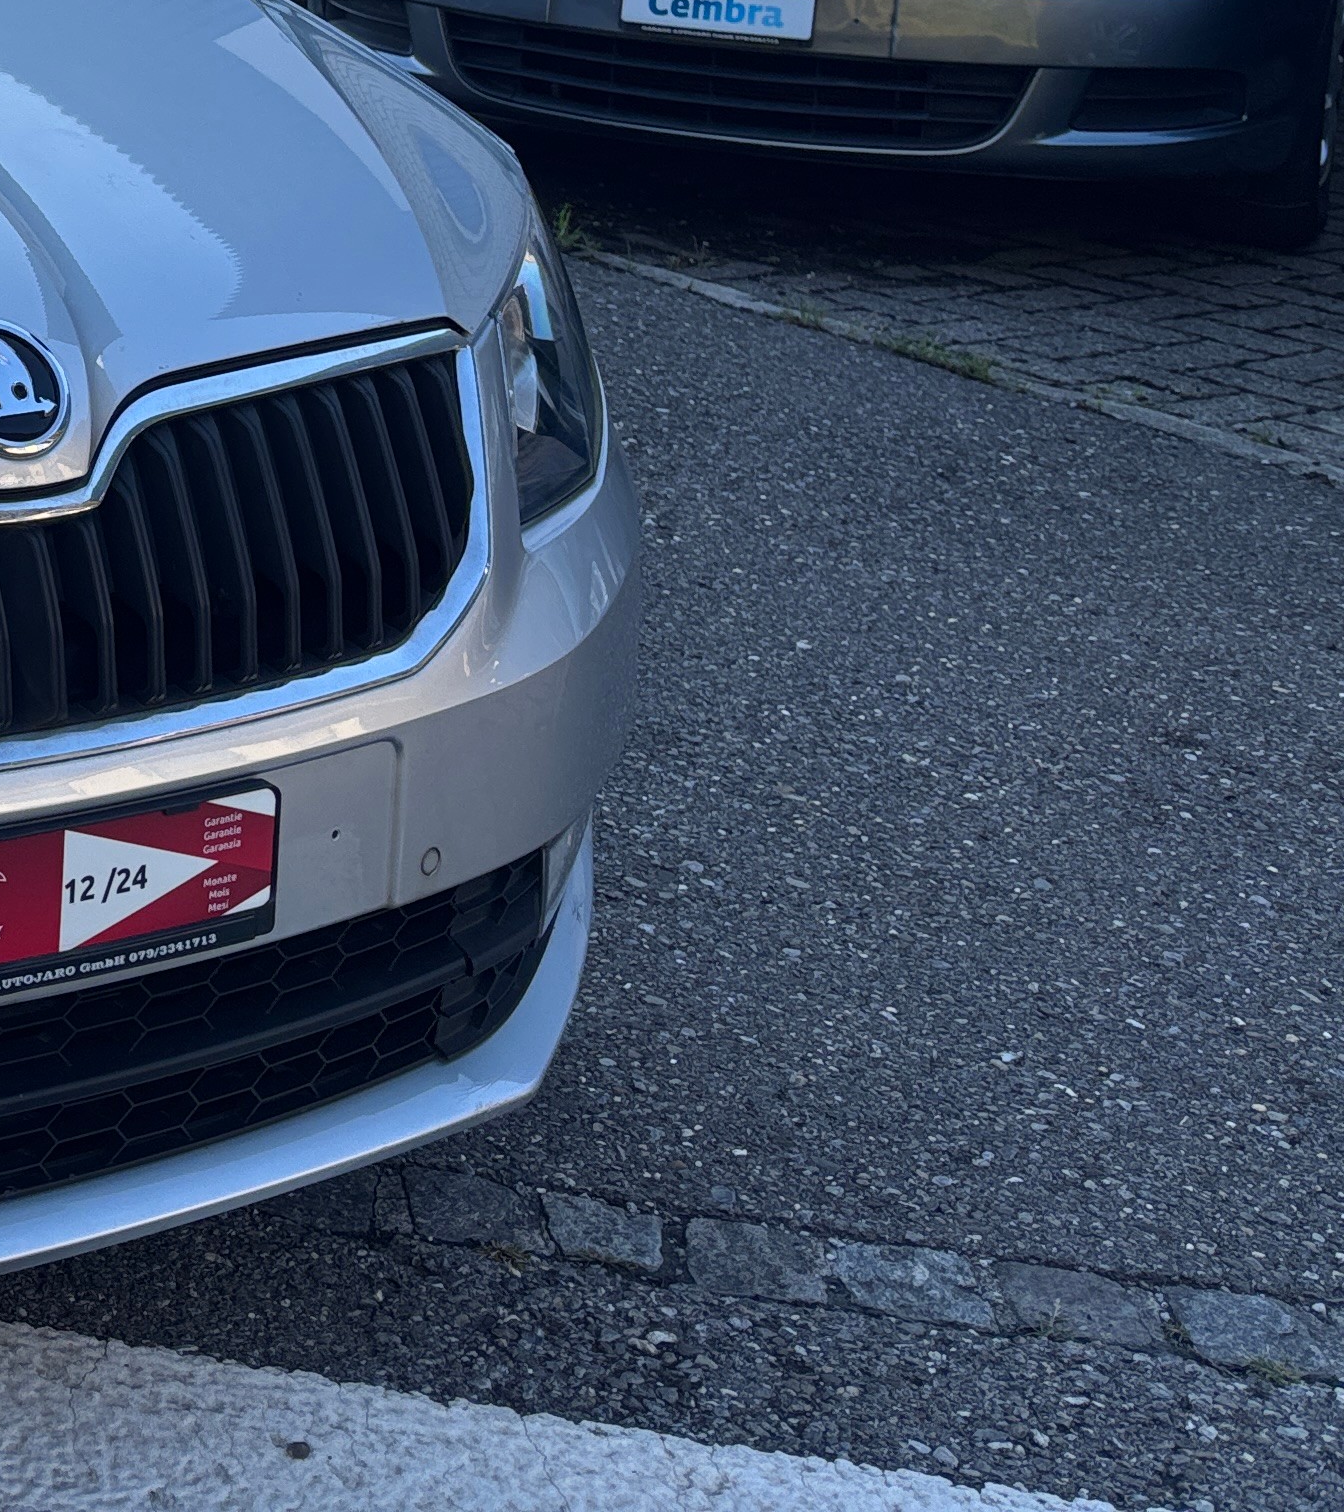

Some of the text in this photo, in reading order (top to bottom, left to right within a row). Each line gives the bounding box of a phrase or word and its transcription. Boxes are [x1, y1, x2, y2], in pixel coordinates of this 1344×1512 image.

[204, 811, 243, 828] Garantie
[203, 825, 242, 841] Garantie
[202, 838, 242, 855] Garanzia
[203, 873, 238, 888] Monate
[208, 887, 230, 900] Mois
[79, 954, 126, 974] GmbH
